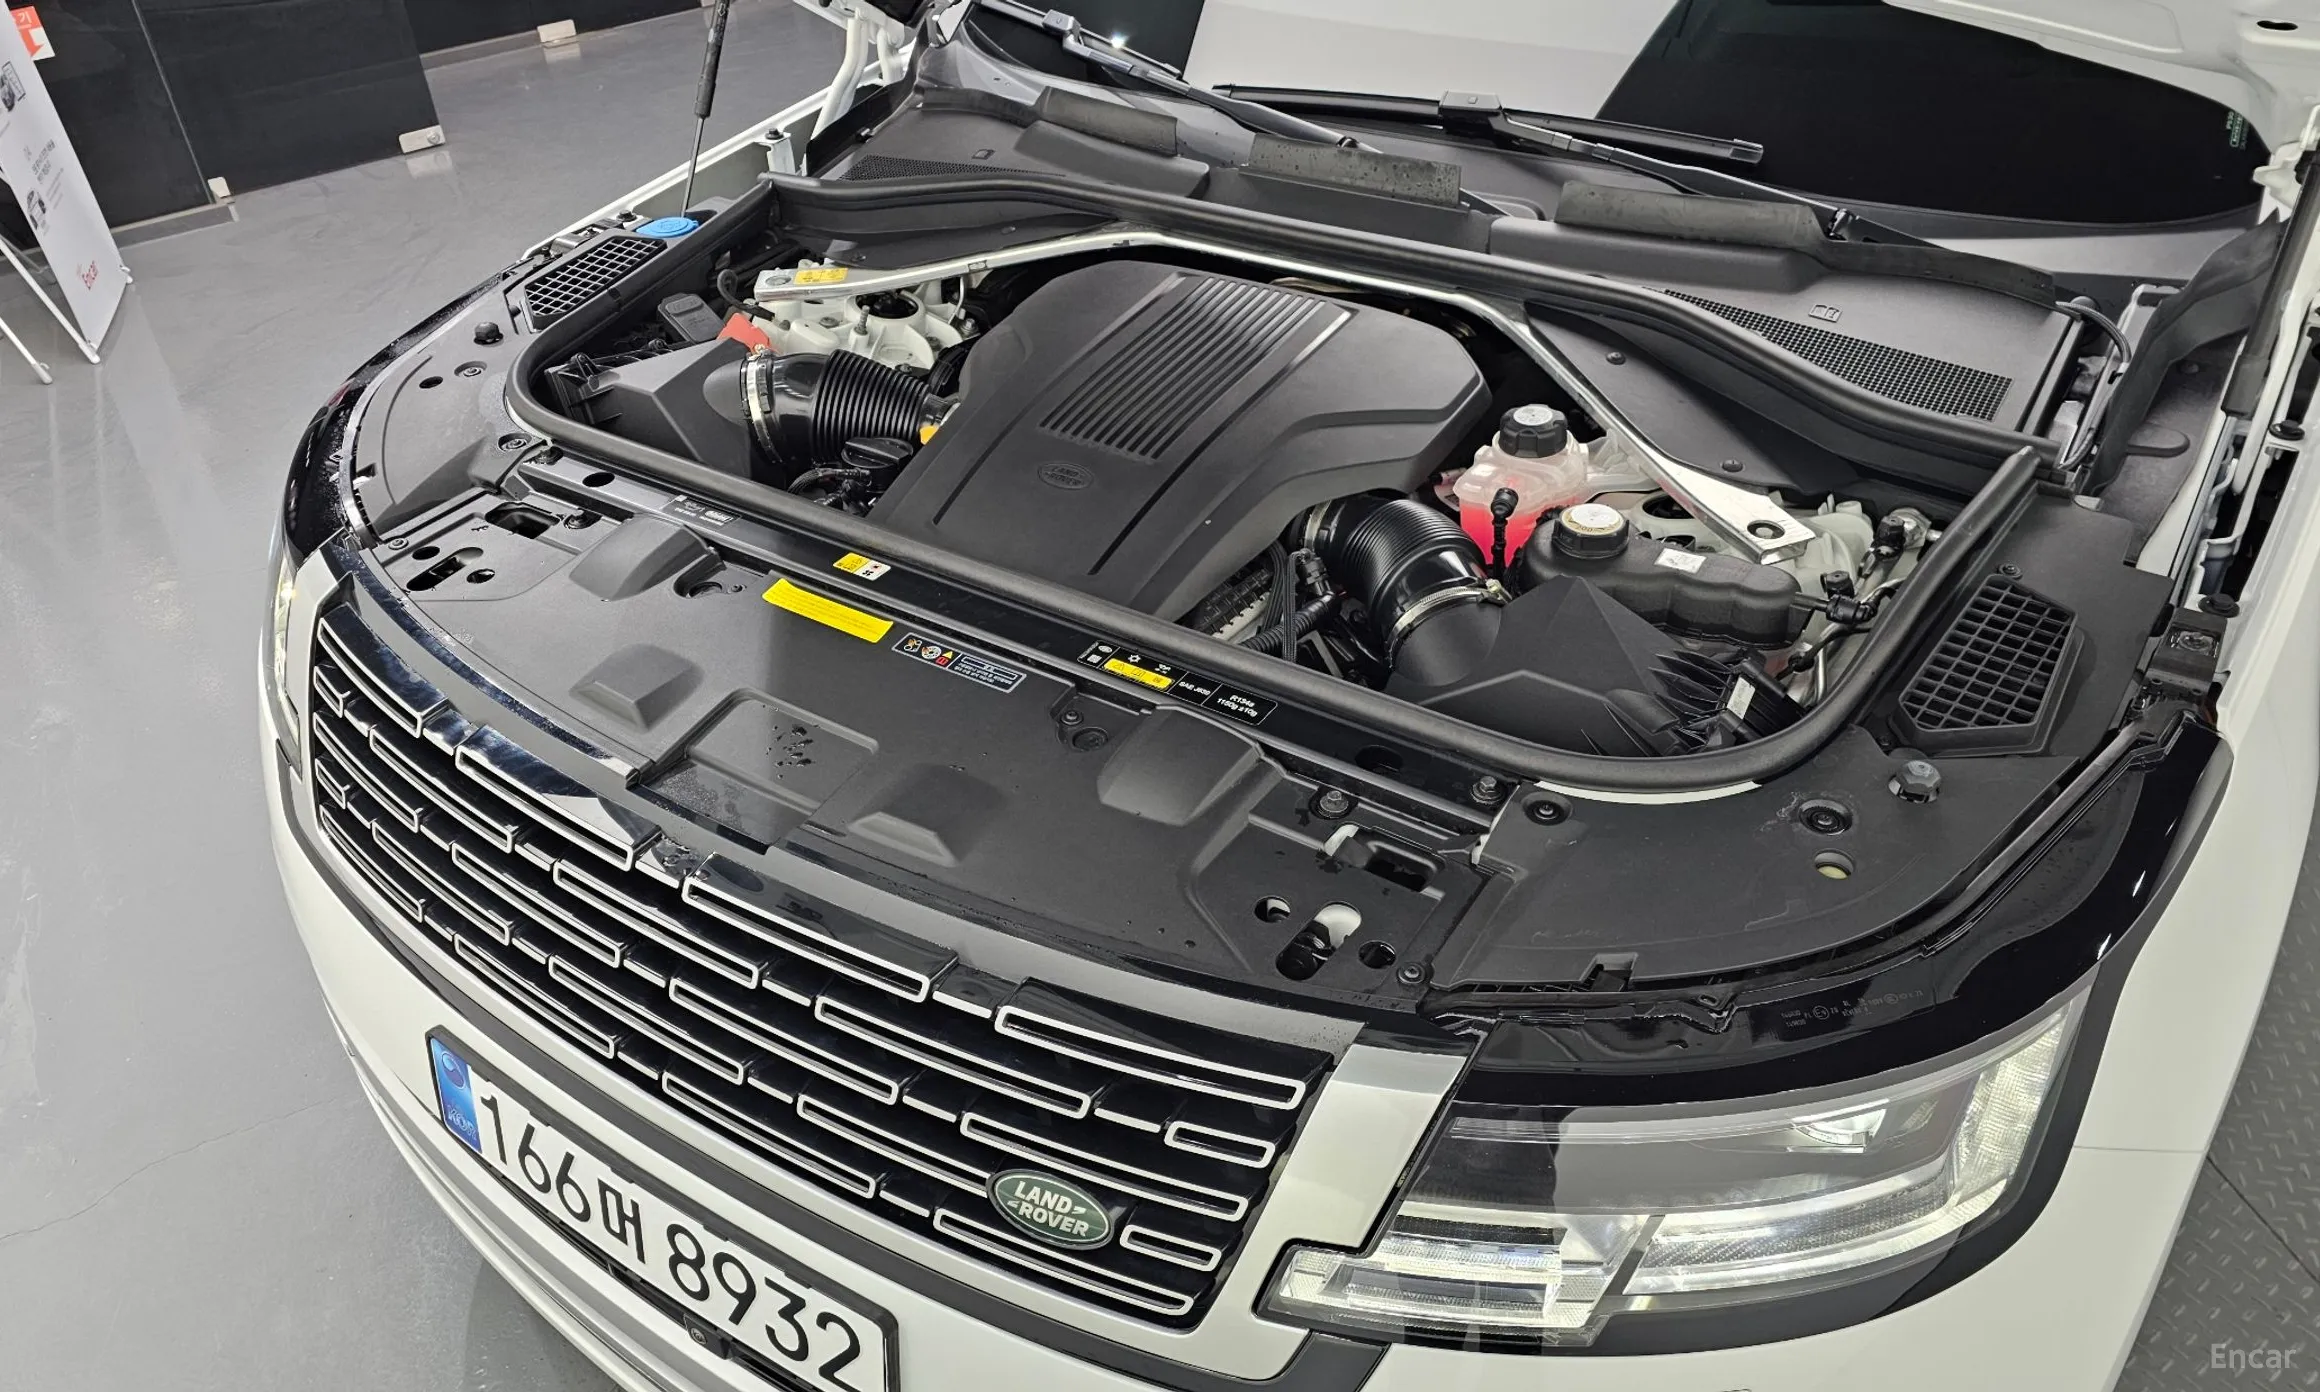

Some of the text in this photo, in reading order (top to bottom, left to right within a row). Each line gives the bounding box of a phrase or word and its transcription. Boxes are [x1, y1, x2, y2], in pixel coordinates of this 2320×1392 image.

[1229, 694, 1255, 708] R134a
[447, 1107, 478, 1141] KOR
[1014, 1181, 1073, 1215] LAND
[1018, 1201, 1090, 1237] ROVER
[479, 1094, 861, 1392] 166머 8932
